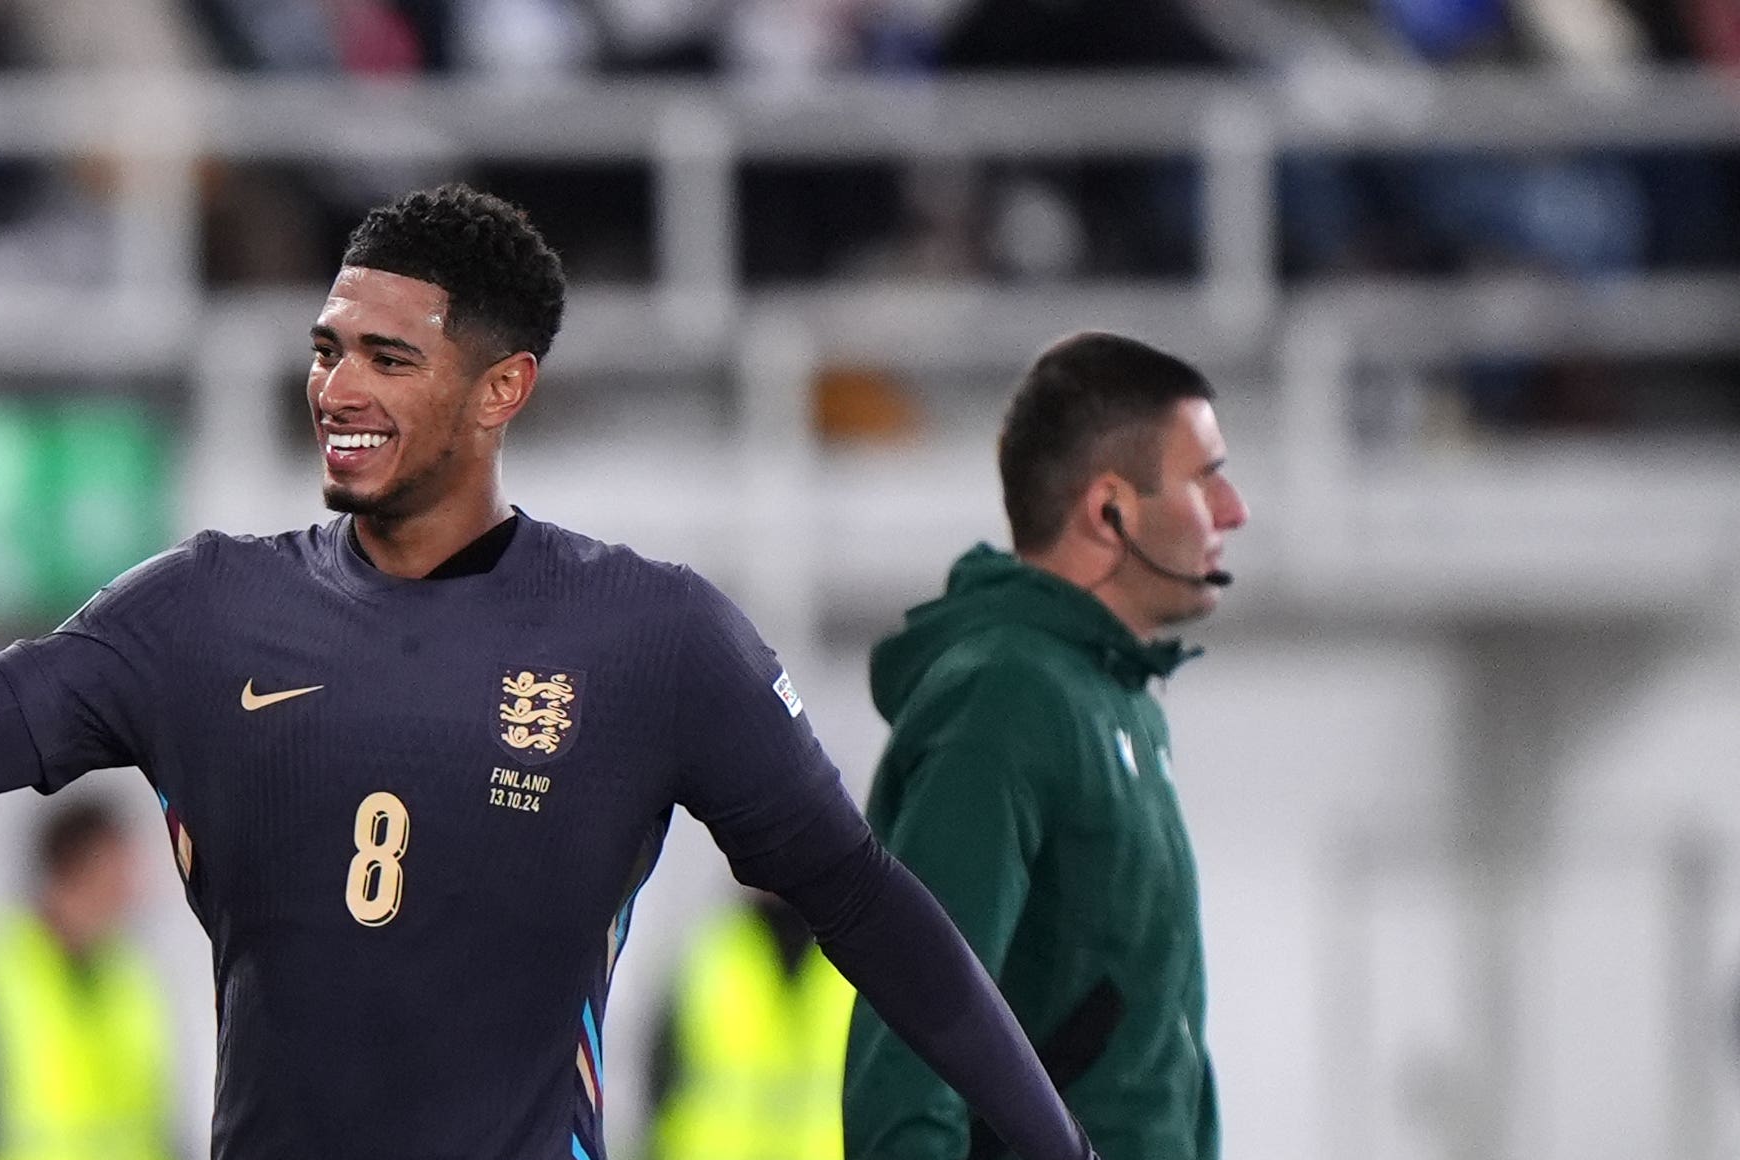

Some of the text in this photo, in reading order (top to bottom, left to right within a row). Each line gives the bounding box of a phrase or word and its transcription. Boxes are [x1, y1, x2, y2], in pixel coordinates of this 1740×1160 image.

[490, 766, 551, 794] FINLAND
[489, 788, 541, 813] 13.10.24
[345, 791, 410, 927] 8
